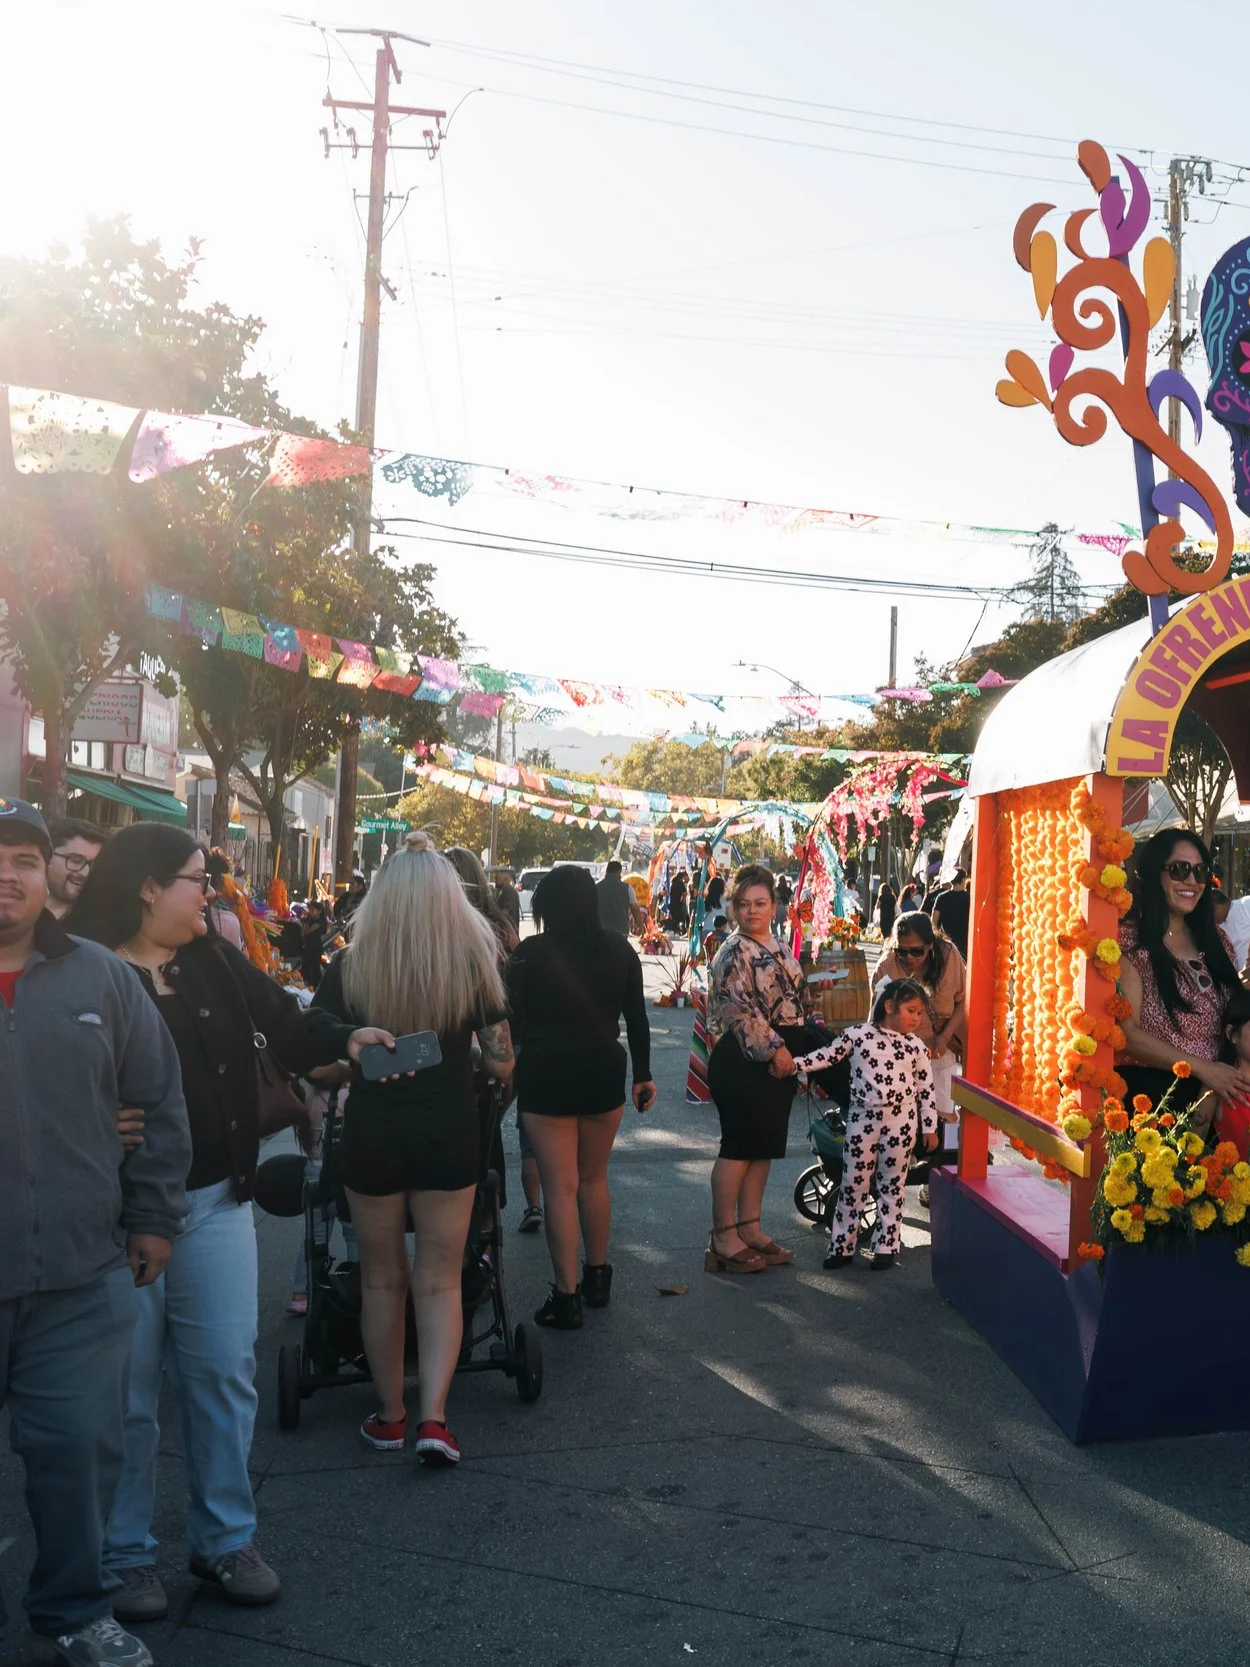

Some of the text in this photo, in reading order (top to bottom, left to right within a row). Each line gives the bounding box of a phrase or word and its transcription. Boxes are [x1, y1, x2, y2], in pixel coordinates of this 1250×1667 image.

[1117, 718, 1170, 773] LA
[361, 820, 406, 831] Gourmet Alley
